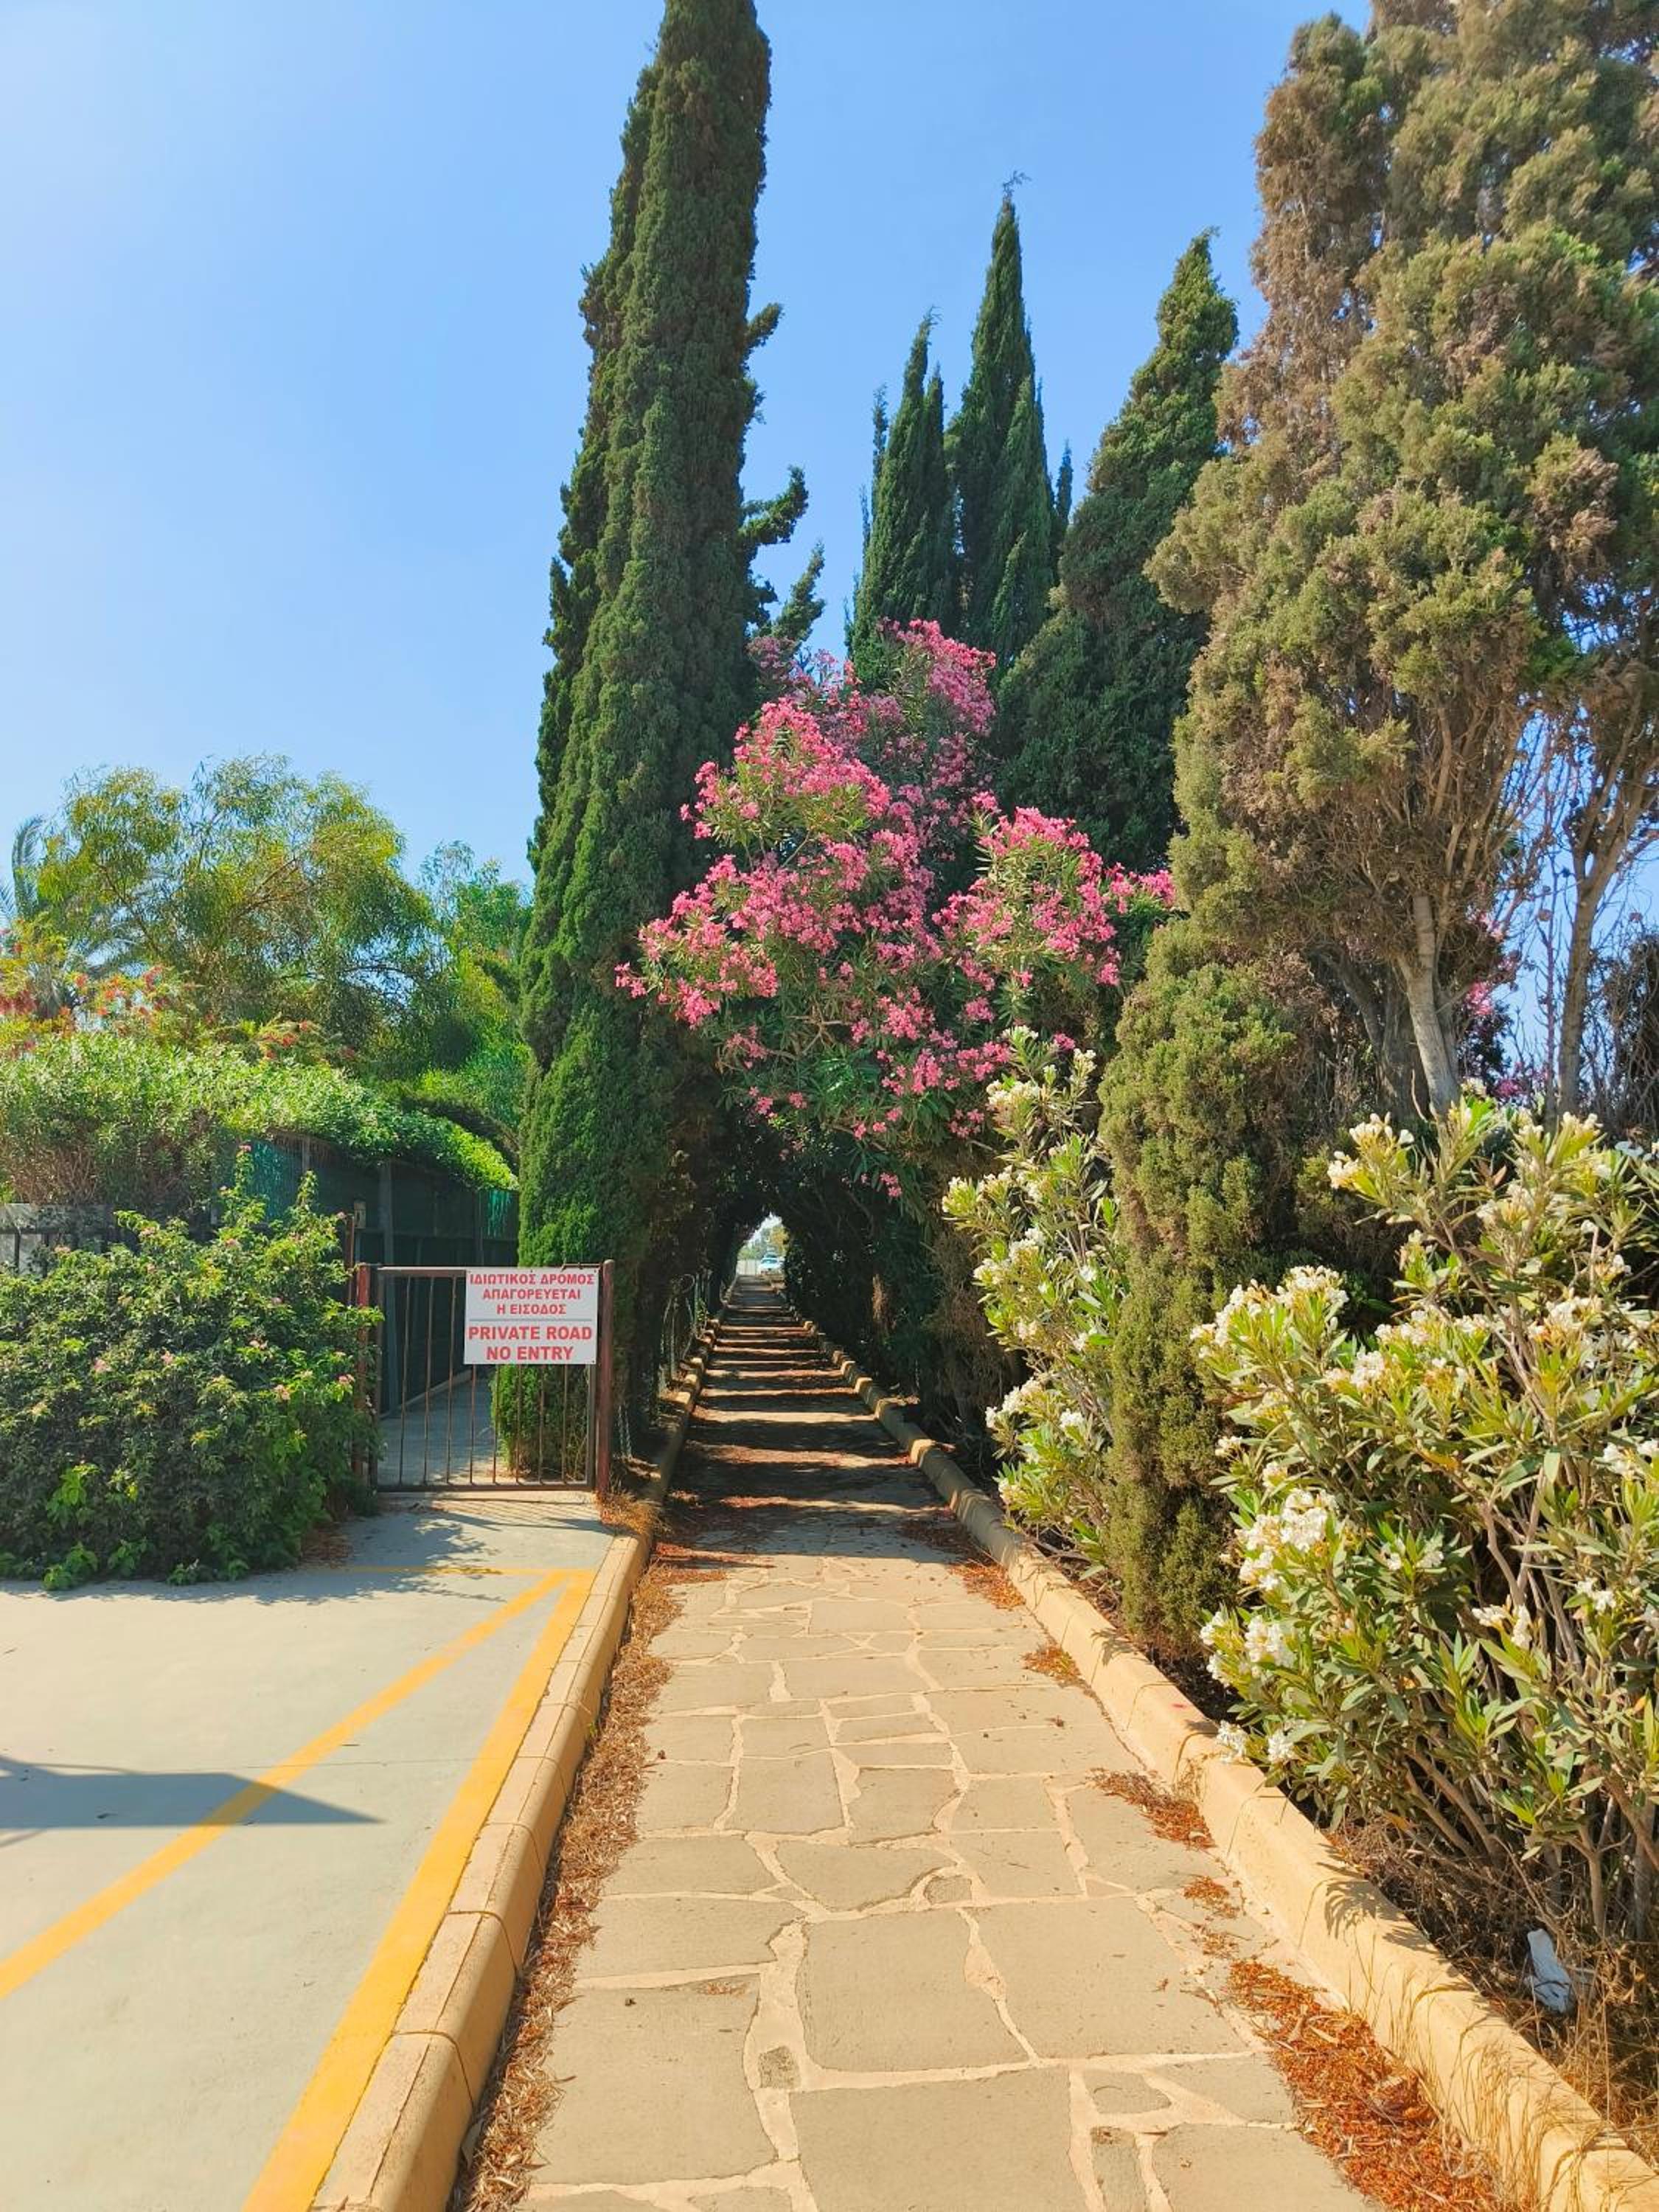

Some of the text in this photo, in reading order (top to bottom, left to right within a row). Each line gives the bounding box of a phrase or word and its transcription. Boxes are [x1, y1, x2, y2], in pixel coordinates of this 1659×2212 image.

[470, 1273, 594, 1284] ΙΔΙΩΤΙΚΟΣ ΔΡΟΜΟΣ
[483, 1289, 581, 1300] ΑΠΑΓΟΡΕΥΕΤΑΙ
[496, 1304, 566, 1315] Η ΕΙΣΟΔΟΣ
[468, 1326, 592, 1340] PRIVATE ROAD
[487, 1346, 574, 1360] NO ENTRY
